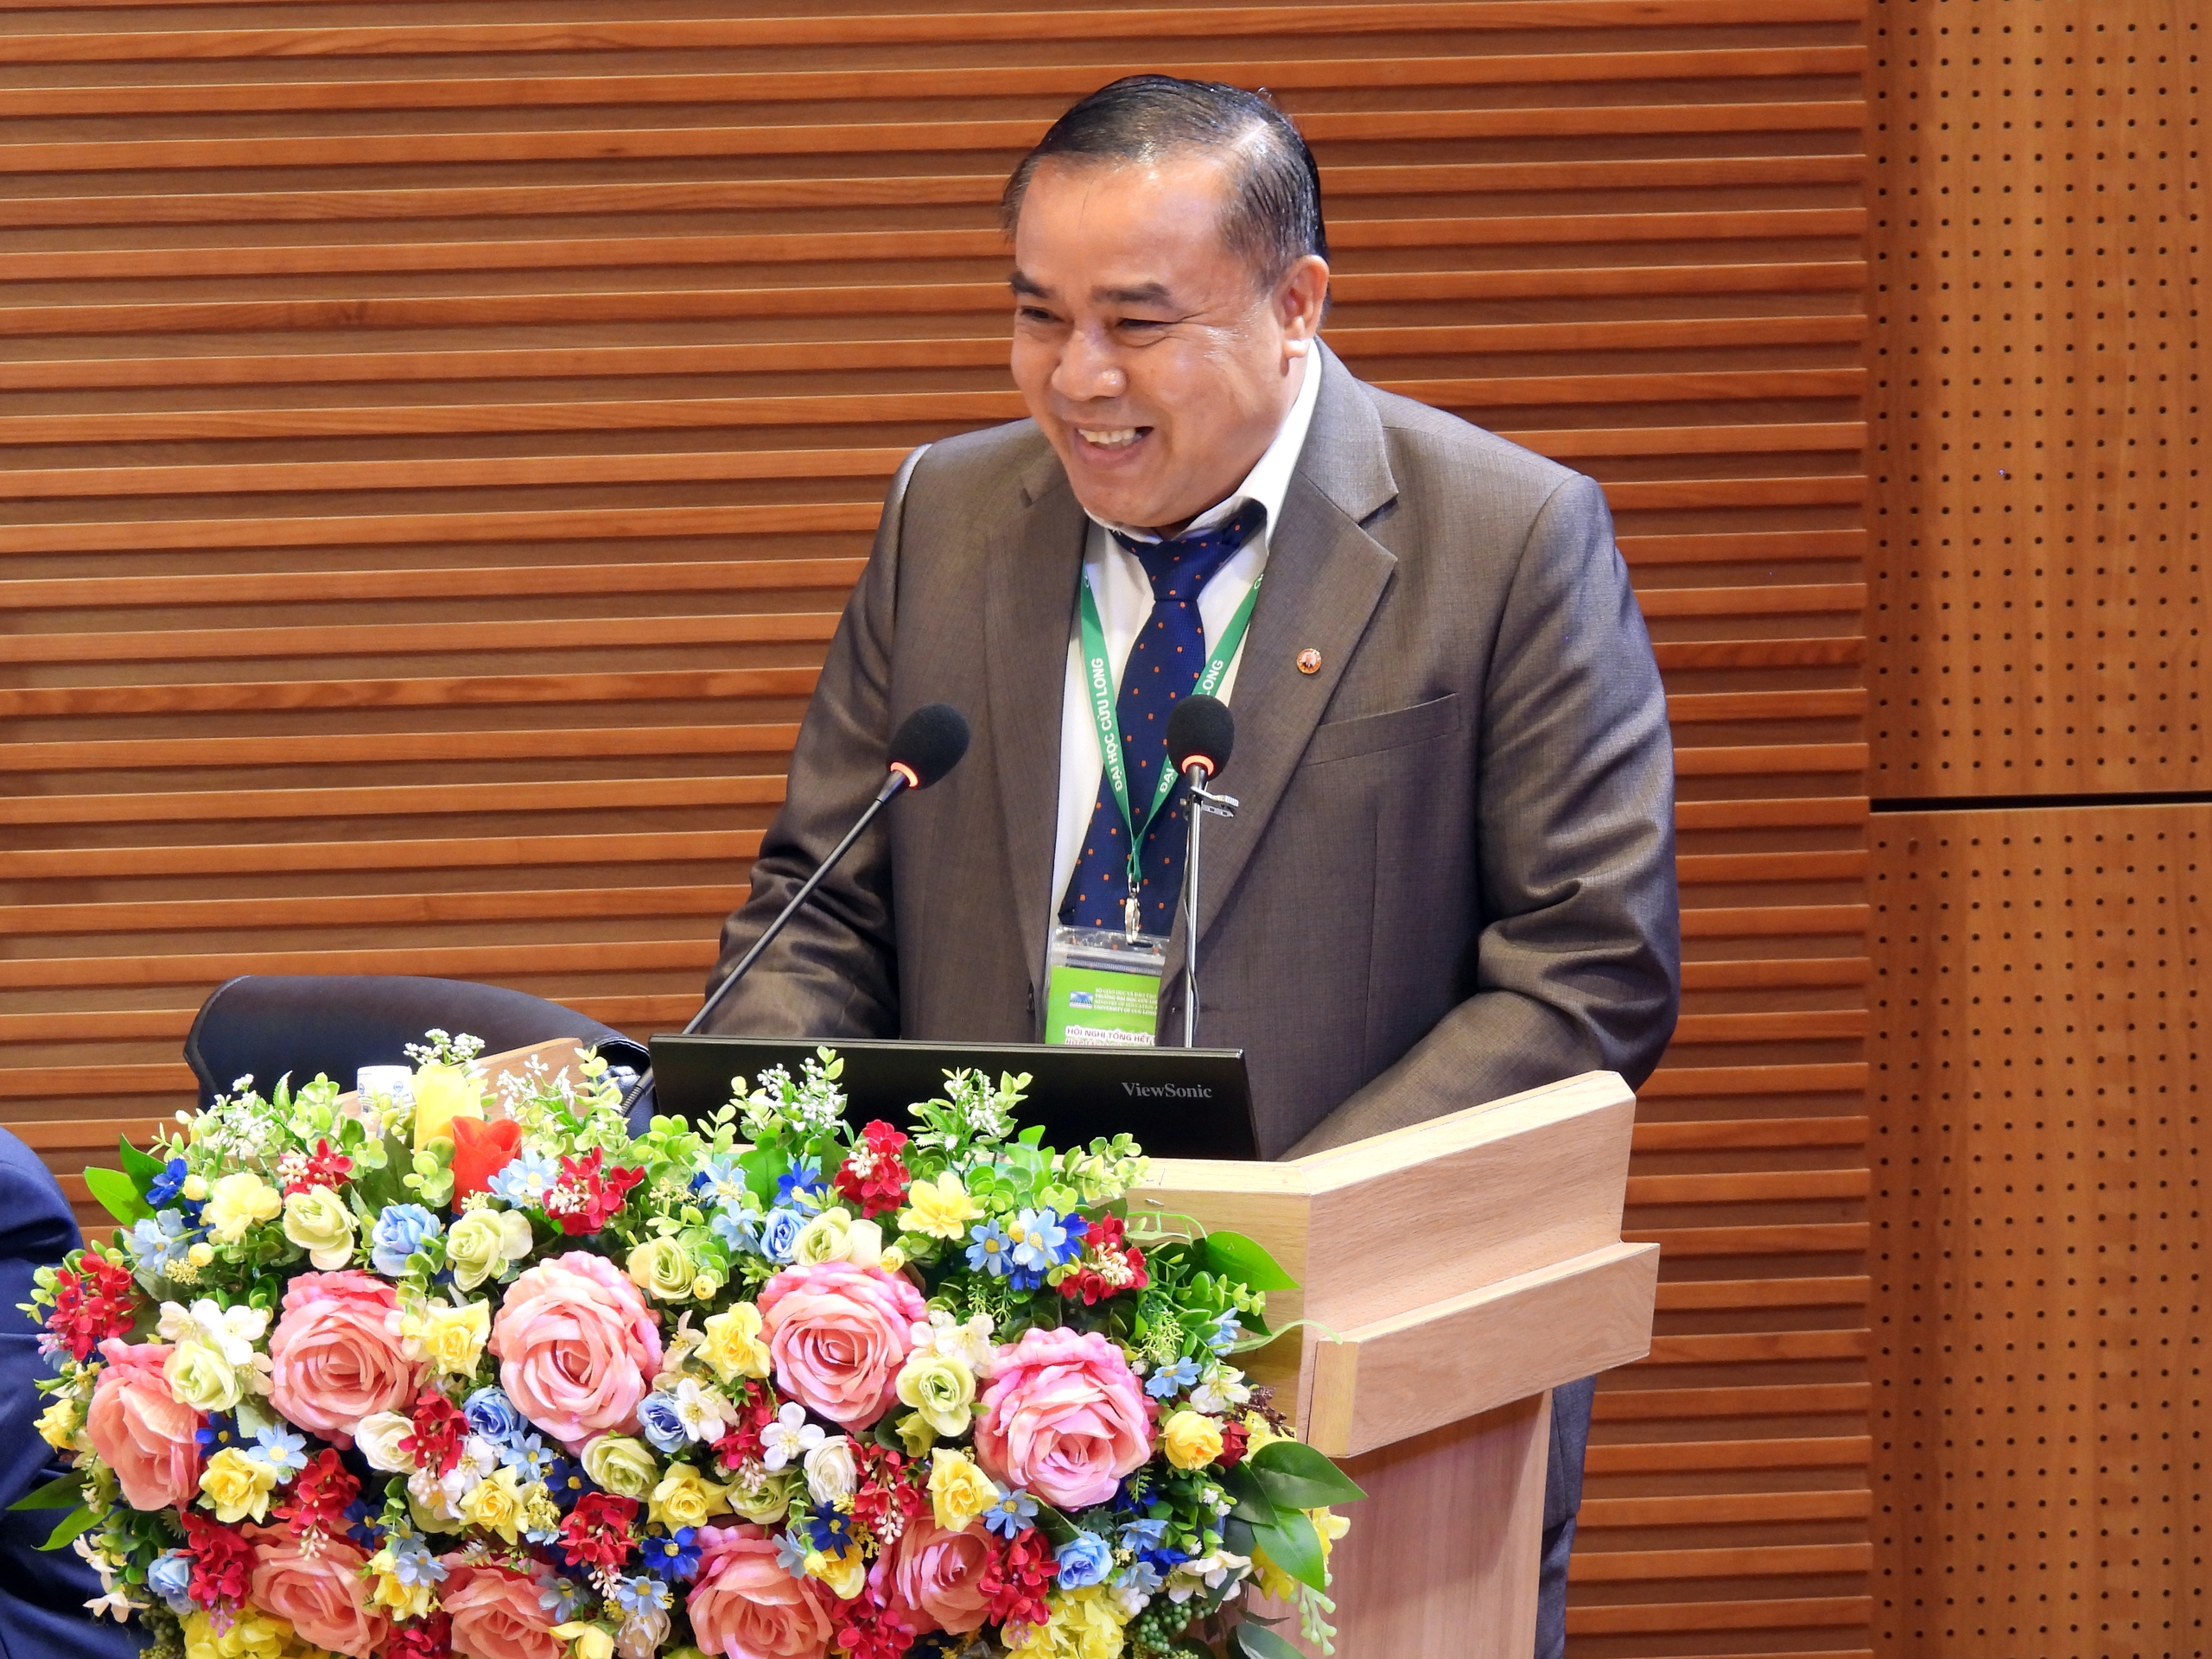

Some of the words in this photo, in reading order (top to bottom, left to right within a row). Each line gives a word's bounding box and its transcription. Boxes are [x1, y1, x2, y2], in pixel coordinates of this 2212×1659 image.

[1091, 658, 1107, 697] LONG
[1199, 659, 1224, 696] ONG
[1096, 699, 1112, 731] CỬU
[1104, 733, 1118, 765] HỌC
[1110, 766, 1122, 791] ĐẠI
[1122, 1082, 1213, 1098] ViewSonic
